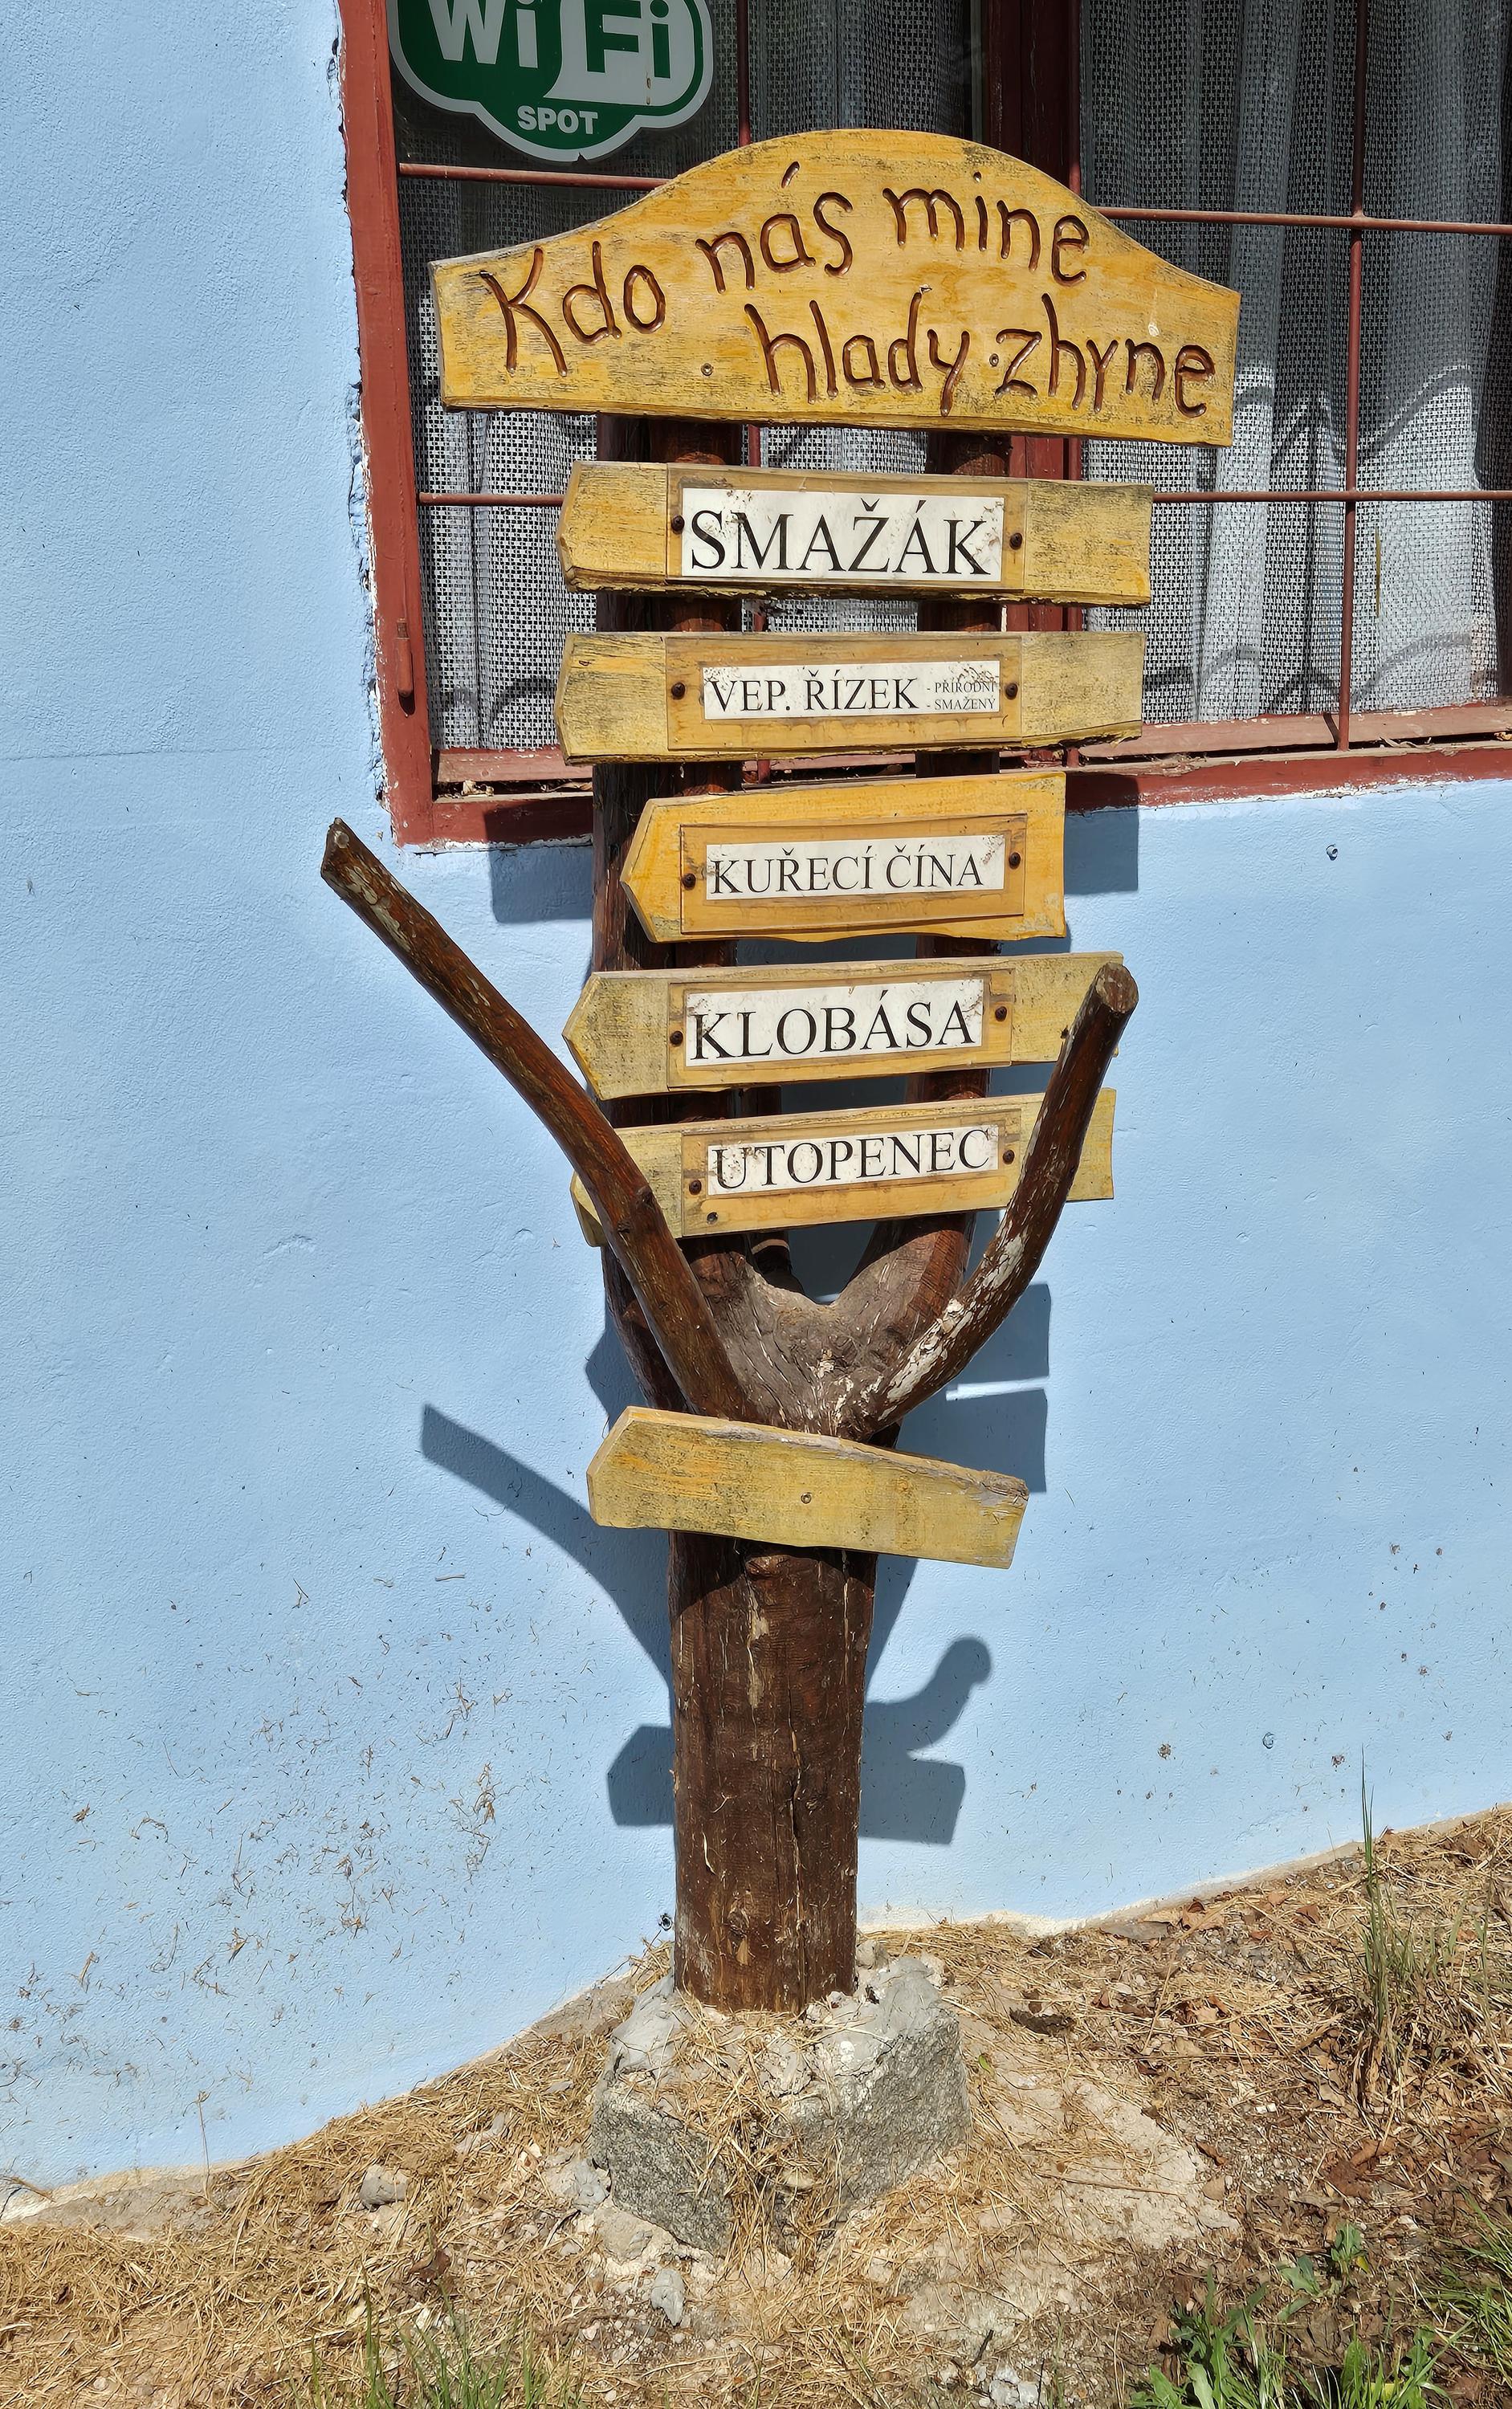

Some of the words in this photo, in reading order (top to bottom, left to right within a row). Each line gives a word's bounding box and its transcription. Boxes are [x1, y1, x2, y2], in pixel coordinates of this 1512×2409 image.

[517, 105, 598, 134] SPOT
[480, 240, 666, 377] Kdo
[695, 161, 853, 294] nás
[882, 170, 1090, 287] mine
[744, 291, 970, 417] hlady
[994, 292, 1216, 418] zhyne
[691, 498, 992, 576] SMAŽÁK
[707, 679, 791, 711] VEP.
[804, 669, 919, 710] ŘÍZEK
[935, 695, 996, 711] SMAŽENÝ
[711, 846, 874, 894] KUŘECÍ
[886, 846, 984, 888] ČÍNA
[691, 990, 976, 1061] KLOBÁSA
[713, 1129, 990, 1190] UTOPENEC
